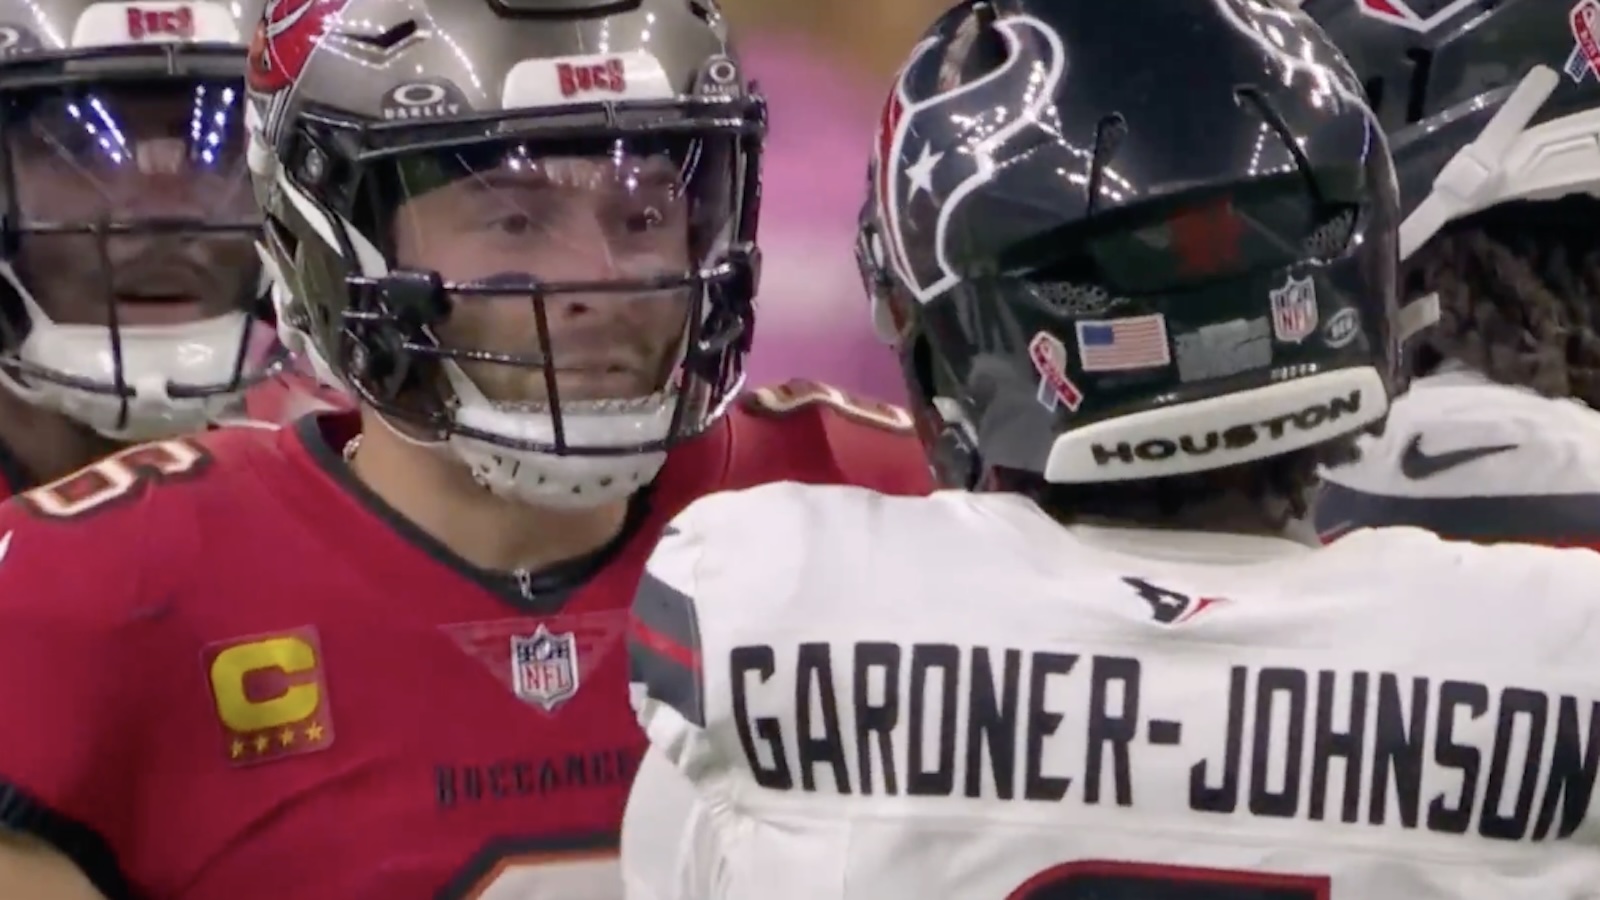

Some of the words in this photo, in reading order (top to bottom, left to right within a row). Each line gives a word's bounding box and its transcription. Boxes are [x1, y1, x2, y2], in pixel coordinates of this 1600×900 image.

[1091, 390, 1361, 465] HOUSTON
[210, 637, 320, 732] C
[523, 663, 570, 691] NFL
[730, 641, 1600, 841] GARDNER-JOHNSON
